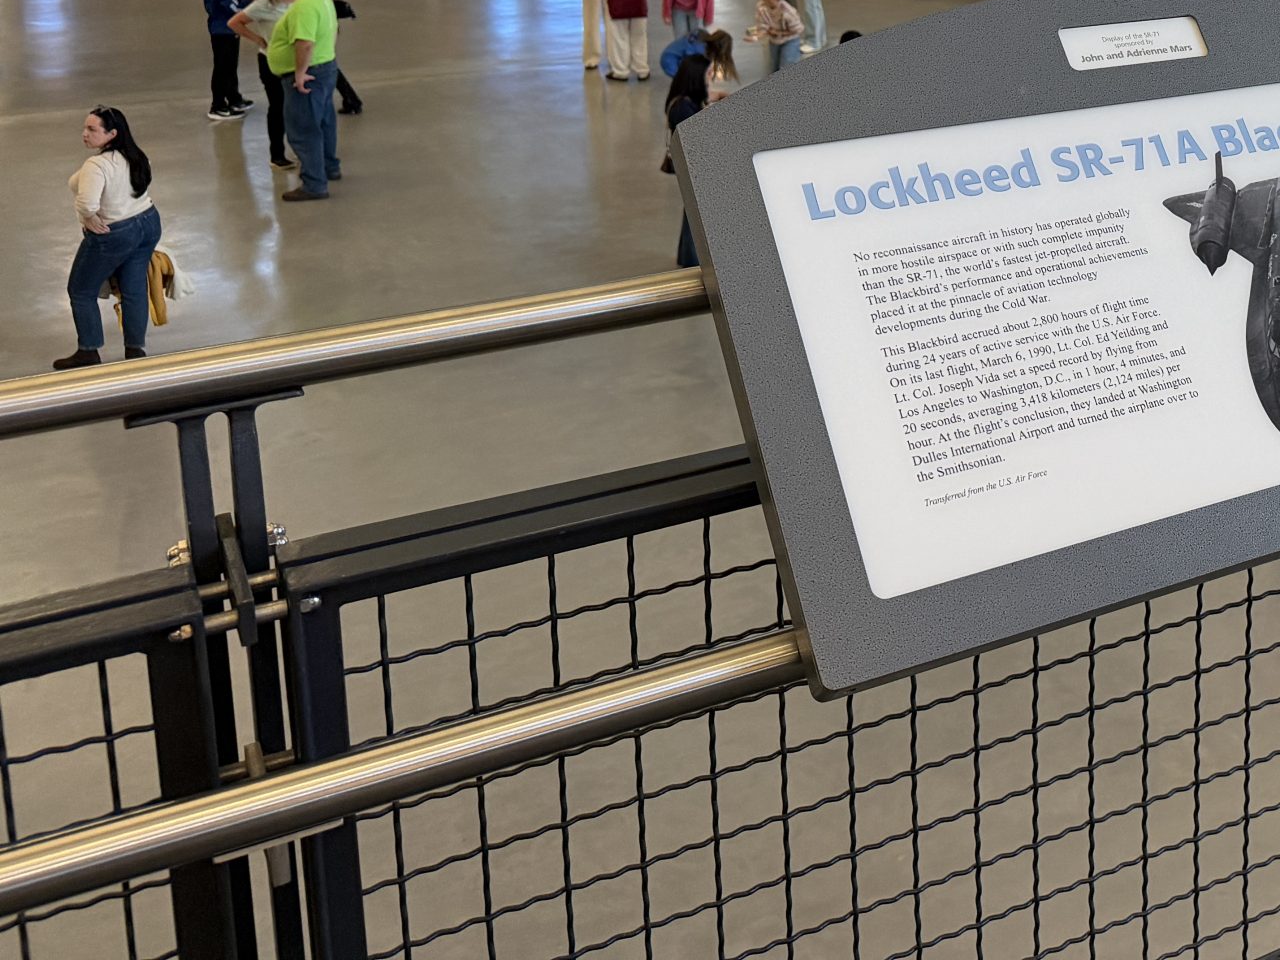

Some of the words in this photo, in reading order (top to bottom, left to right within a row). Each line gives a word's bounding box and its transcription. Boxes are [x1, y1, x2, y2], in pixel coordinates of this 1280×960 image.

[1081, 54, 1103, 63] John
[1106, 51, 1124, 60] and
[1126, 47, 1168, 58] Adrienne
[1170, 44, 1193, 53] Mars
[1114, 40, 1145, 48] sponsored
[802, 147, 1041, 221] Lockheed
[852, 252, 871, 262] No
[871, 240, 950, 259] reconnaissance
[951, 231, 988, 246] aircraft
[988, 231, 1000, 239] in
[999, 225, 1034, 237] history
[1034, 222, 1053, 231] has
[1053, 213, 1094, 230] operated
[1094, 208, 1129, 223] globally
[858, 268, 870, 277] in
[870, 264, 900, 275] more
[899, 255, 936, 269] hostile
[937, 250, 979, 263] airspace
[979, 247, 991, 255] or
[992, 241, 1016, 253] with
[1016, 237, 1040, 249] such
[1040, 231, 1084, 244] complete
[1084, 224, 1124, 237] impunity
[861, 281, 887, 291] than
[886, 276, 905, 287] the
[905, 269, 944, 283] SR-71,
[944, 266, 962, 276] the
[1001, 253, 1034, 266] fastest
[1034, 241, 1094, 263] jet-propelled
[1094, 235, 1130, 249] aircraft.
[865, 294, 888, 305] The
[949, 273, 1013, 293] performance
[1014, 266, 1034, 278] and
[1034, 256, 1087, 276] operational
[1087, 247, 1148, 265] achievements
[870, 305, 907, 323] placed
[906, 304, 917, 314] it
[917, 302, 930, 311] at
[929, 299, 948, 309] the
[948, 290, 992, 308] pinnacle
[993, 286, 1006, 297] of
[1006, 281, 1047, 294] aviation
[1046, 271, 1097, 287] technology
[875, 315, 947, 335] developments
[948, 307, 984, 320] during
[983, 303, 1001, 314] the
[1001, 297, 1027, 310] Cold
[1026, 294, 1050, 305] War.
[880, 345, 906, 357] This
[906, 333, 960, 352] Blackbird
[960, 324, 1001, 341] accrued
[1001, 320, 1031, 333] about
[1030, 313, 1060, 328] 2,800
[1059, 309, 1089, 321] hours
[1089, 304, 1101, 315] of
[1101, 300, 1128, 313] flight
[1127, 297, 1150, 307] time
[885, 358, 922, 373] during
[920, 353, 937, 365] 24
[937, 349, 968, 364] years
[968, 344, 981, 355] of
[982, 340, 1014, 353] active
[1014, 332, 1051, 346] service
[1050, 325, 1074, 338] with
[1074, 323, 1092, 333] the
[1090, 318, 1114, 329] U.S.
[1115, 314, 1131, 325] Air
[1130, 310, 1161, 321] Force.
[889, 377, 908, 387] On
[908, 374, 924, 384] its
[923, 369, 946, 380] last
[945, 362, 980, 376] flight,
[978, 353, 1014, 369] March
[1014, 351, 1029, 361] 6,
[1027, 345, 1057, 358] 1990,
[1055, 342, 1073, 352] Lt.
[1072, 336, 1096, 348] Col.
[1094, 332, 1111, 344] Ed
[1109, 325, 1152, 340] Yeilding
[1151, 320, 1169, 332] and
[893, 393, 912, 403] Lt.
[912, 385, 937, 399] Col.
[937, 377, 975, 394] Joseph
[974, 372, 1002, 385] Vida
[1001, 369, 1018, 379] set
[1019, 368, 1027, 376] a
[1027, 359, 1058, 376] speed
[1057, 351, 1090, 367] record
[1088, 350, 1103, 361] by
[1104, 344, 1135, 358] flying
[1134, 340, 1158, 350] from
[897, 408, 920, 419] Los
[921, 397, 965, 414] Angeles
[965, 395, 978, 403] to
[978, 381, 1044, 400] Washington,
[1042, 373, 1072, 386] D.C.,
[1072, 370, 1086, 380] in
[1085, 367, 1093, 377] 1
[1091, 363, 1120, 375] hour,
[1120, 359, 1127, 368] 4
[1127, 353, 1169, 367] minutes,
[1169, 346, 1187, 358] and
[967, 486, 985, 498] from
[985, 482, 997, 491] the
[1015, 474, 1026, 484] Air
[1027, 470, 1048, 480] Force
